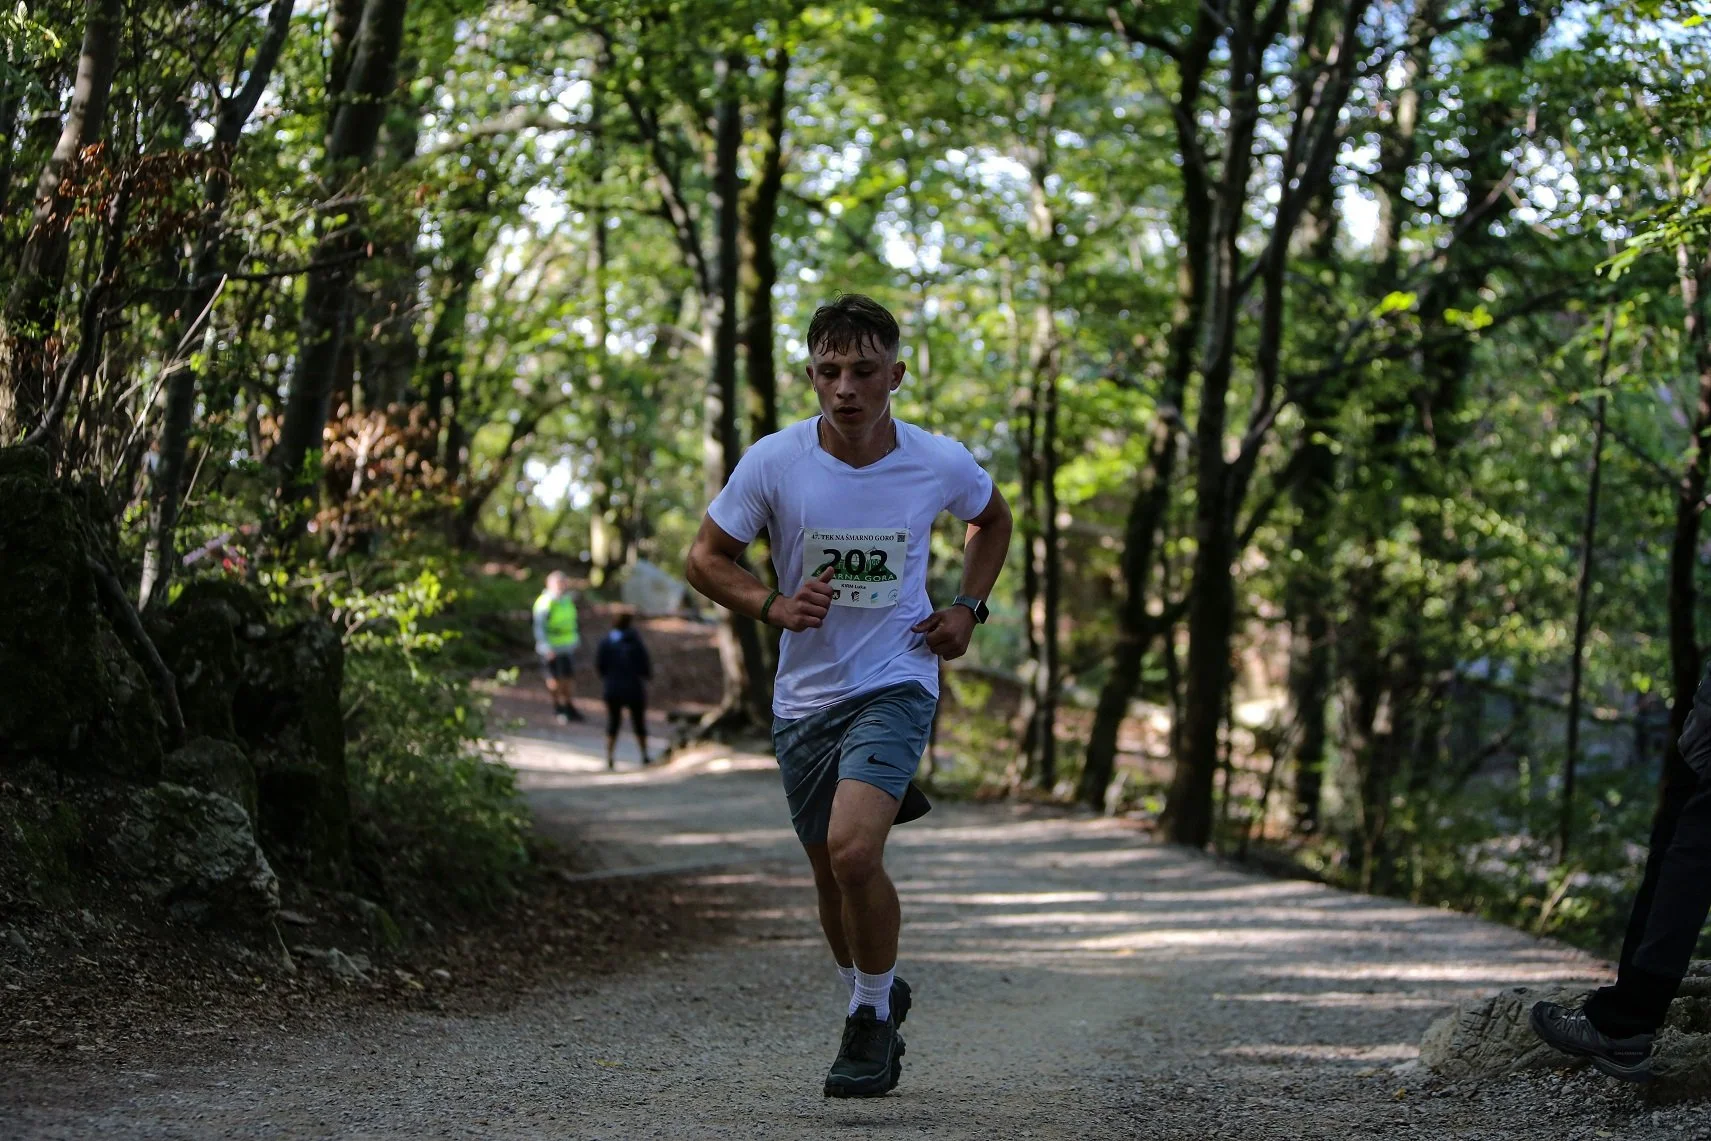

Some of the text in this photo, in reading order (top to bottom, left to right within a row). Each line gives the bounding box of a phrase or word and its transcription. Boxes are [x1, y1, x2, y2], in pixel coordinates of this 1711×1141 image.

[845, 533, 874, 541] ŠMARNO
[823, 549, 888, 576] 202
[864, 574, 895, 582] GORA
